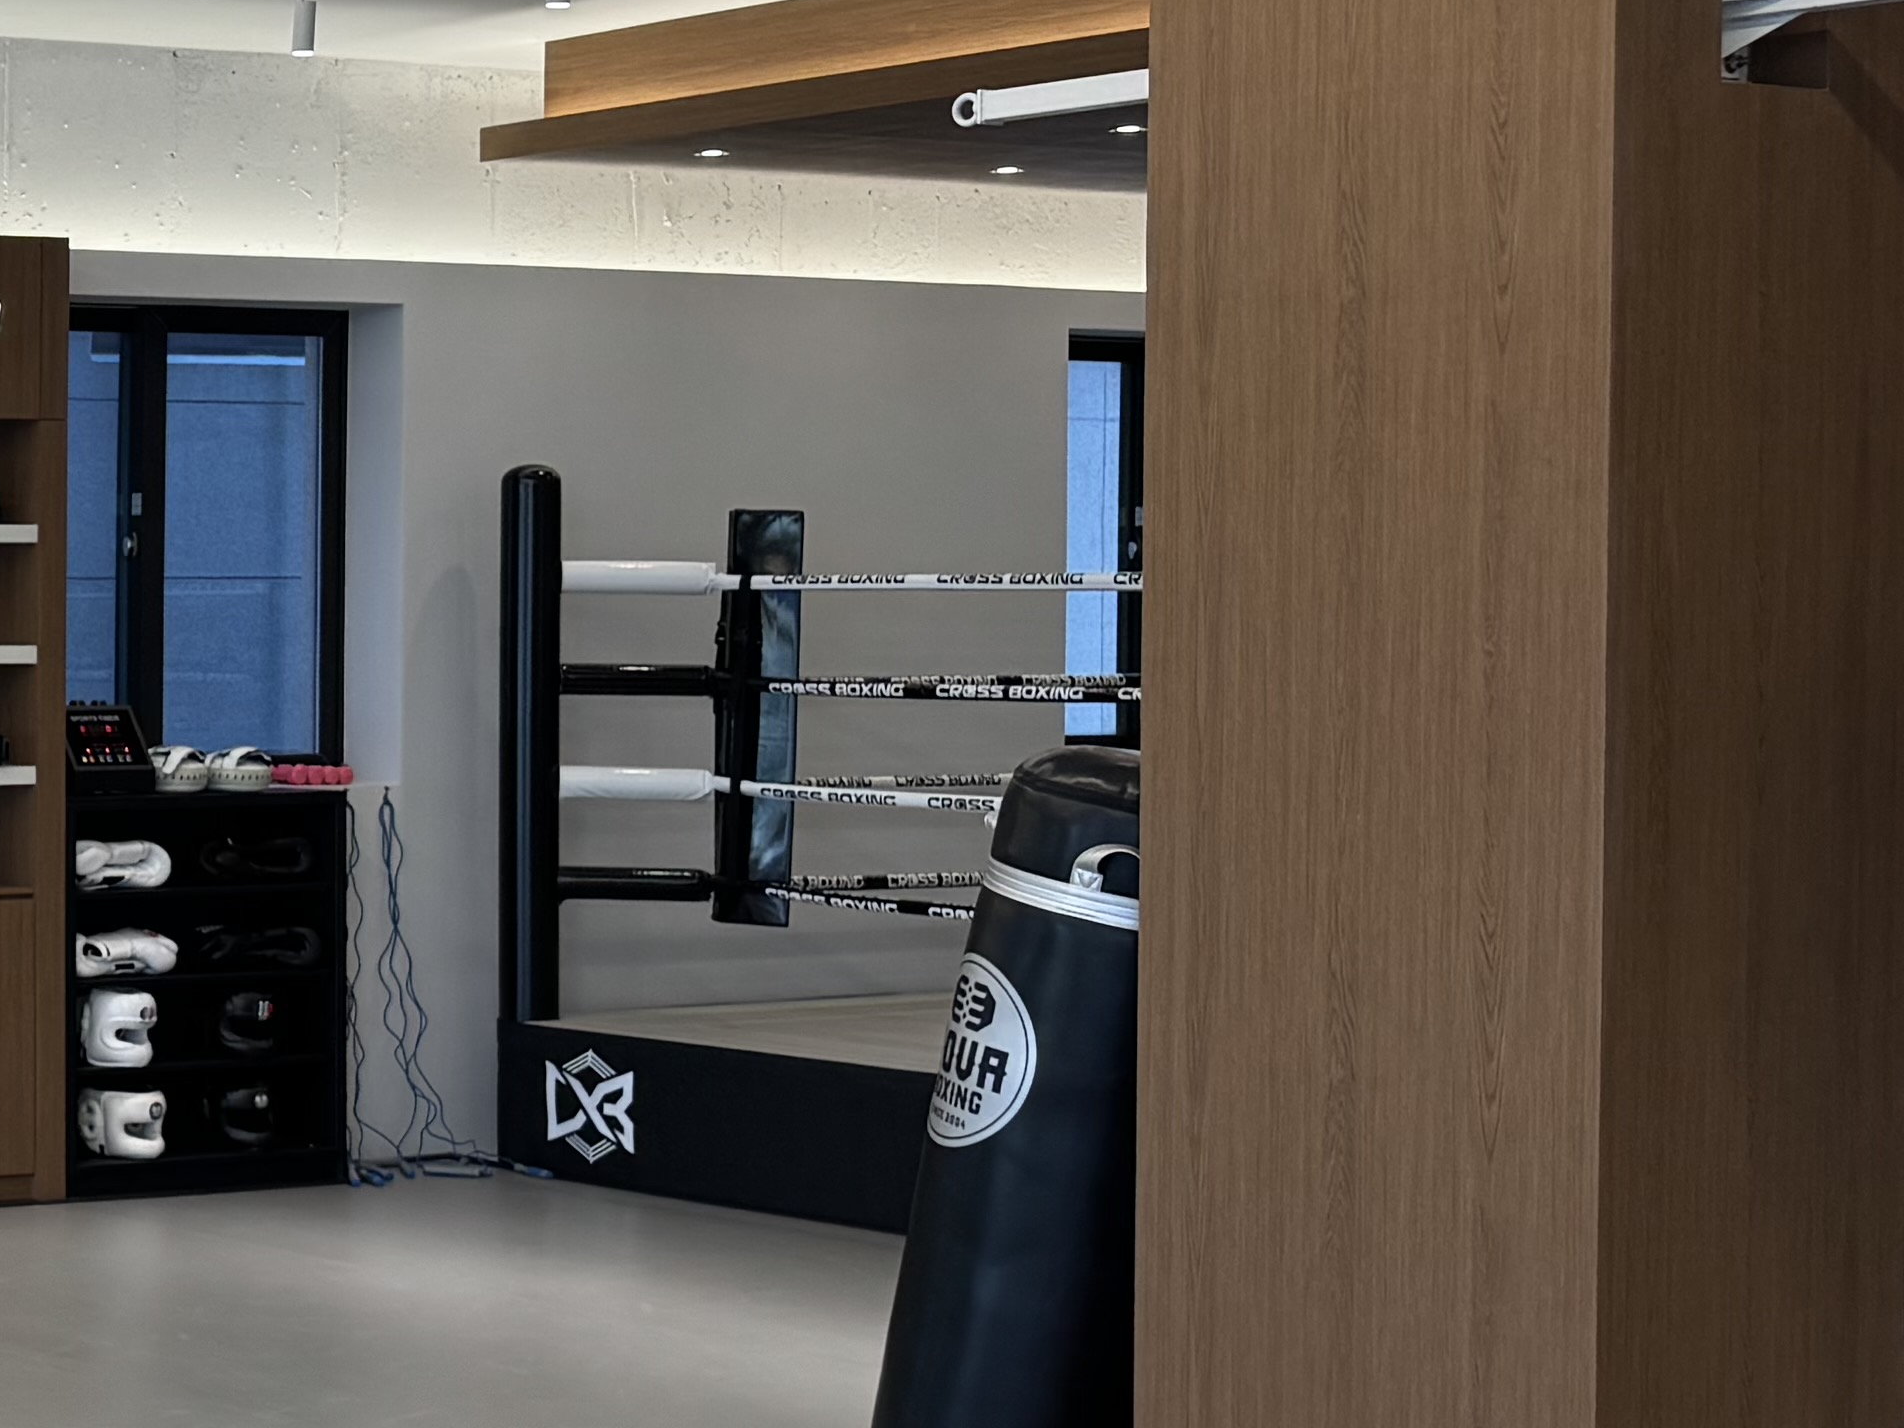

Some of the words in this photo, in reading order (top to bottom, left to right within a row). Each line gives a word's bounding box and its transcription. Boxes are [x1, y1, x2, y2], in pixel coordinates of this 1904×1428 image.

[936, 684, 1004, 699] CROSS
[1009, 685, 1085, 700] BOXING
[928, 797, 995, 811] CROSS
[941, 871, 984, 886] BOXIN
[942, 1029, 1009, 1094] OVA
[935, 1074, 982, 1115] OXING
